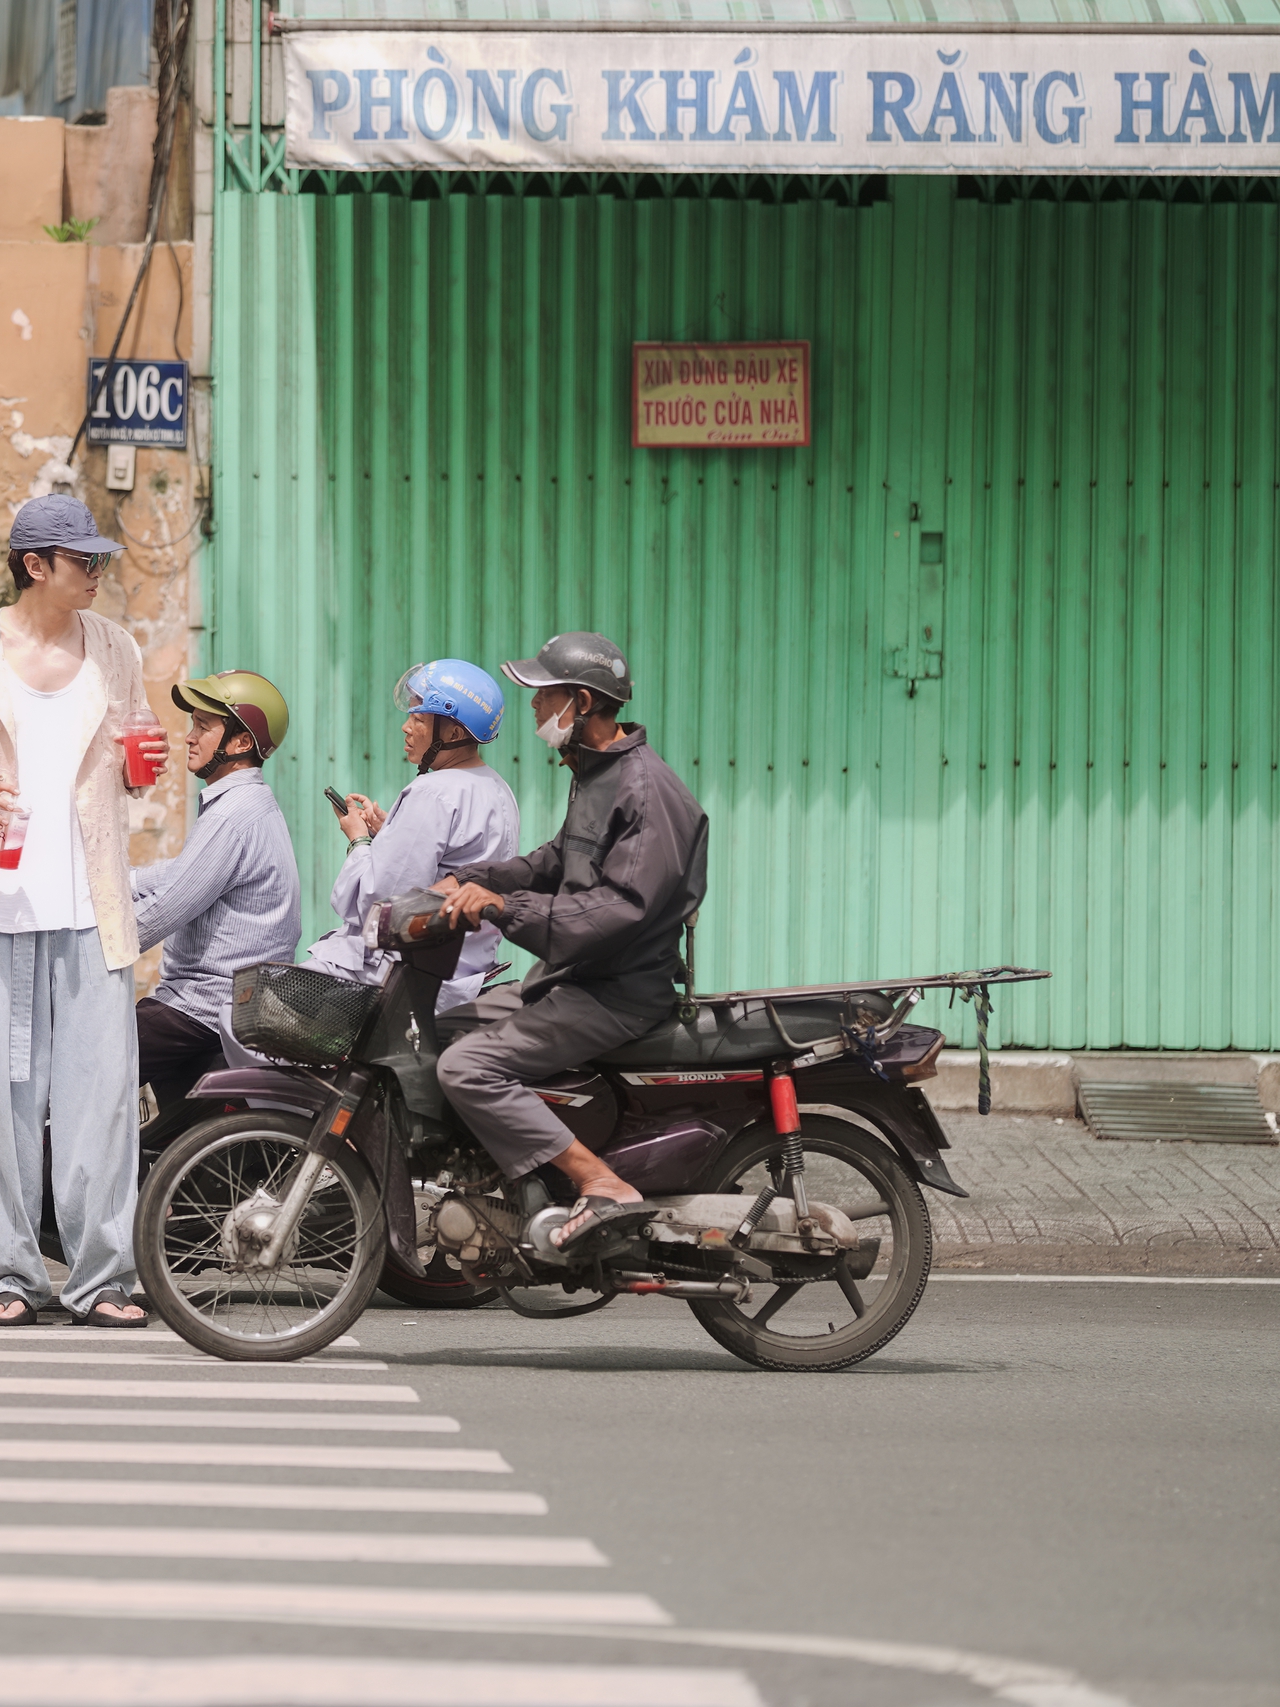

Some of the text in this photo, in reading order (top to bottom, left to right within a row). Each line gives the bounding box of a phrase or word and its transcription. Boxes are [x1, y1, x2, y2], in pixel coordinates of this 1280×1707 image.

[305, 45, 1280, 145] PHÒNG KHÁM RĂNG HÀM
[644, 359, 673, 385] XIN
[734, 352, 770, 391] ĐẬU
[777, 357, 799, 384] XE
[643, 391, 800, 427] TRƯỚC CỬA NHÀ
[579, 650, 614, 668] PIAGGIO
[678, 1073, 726, 1082] HONDA
